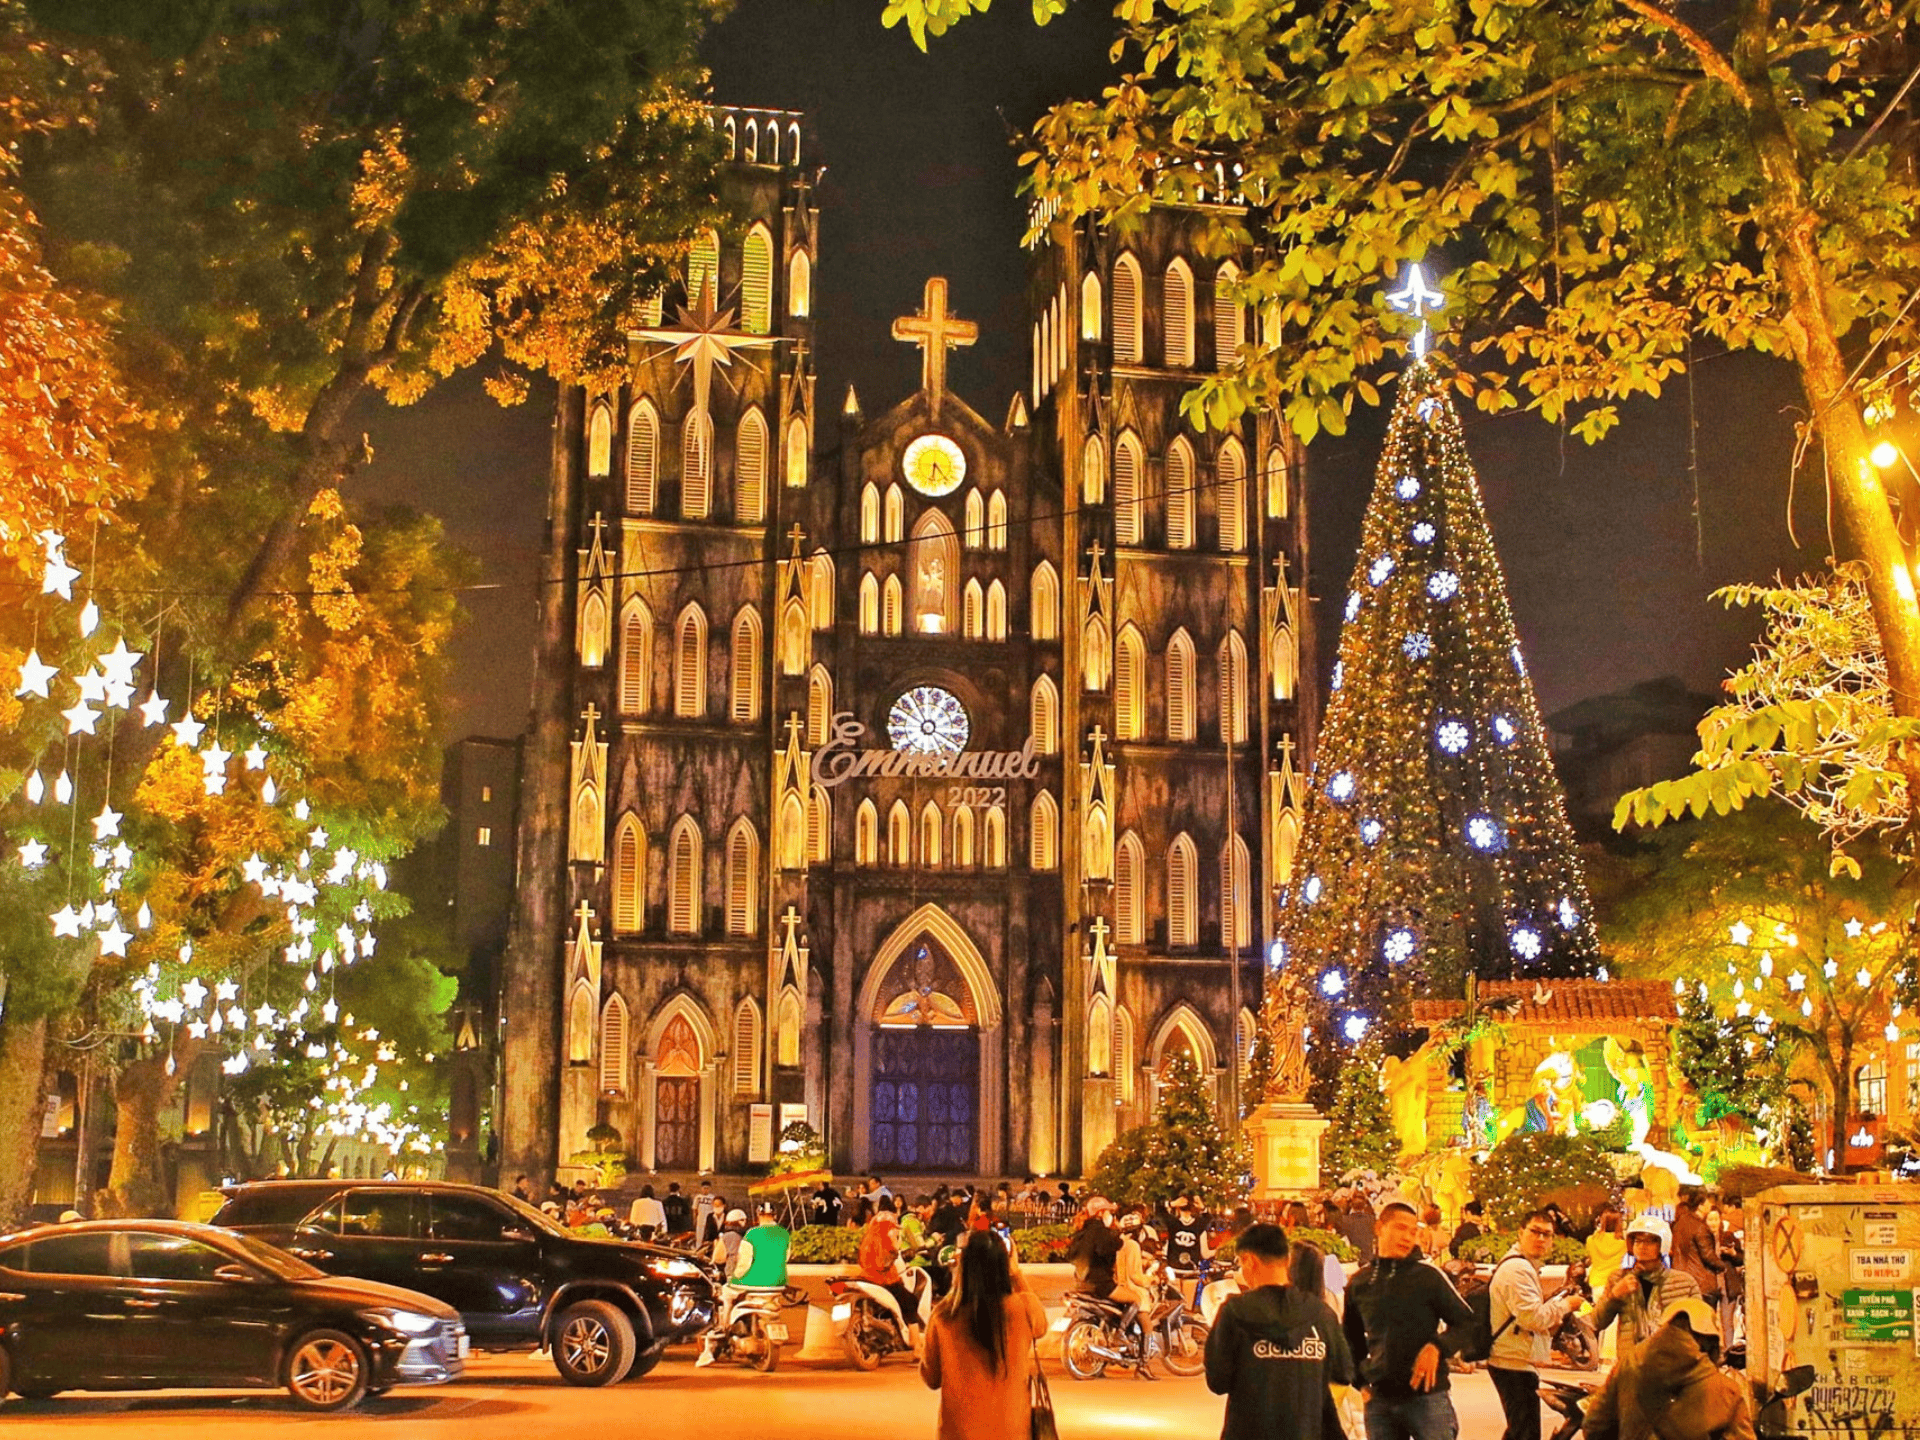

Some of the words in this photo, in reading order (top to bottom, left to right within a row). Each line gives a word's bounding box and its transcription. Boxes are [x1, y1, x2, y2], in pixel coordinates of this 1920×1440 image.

[811, 711, 1040, 787] Emmanuel
[948, 786, 1006, 807] 2022
[1857, 1256, 1871, 1264] TBA
